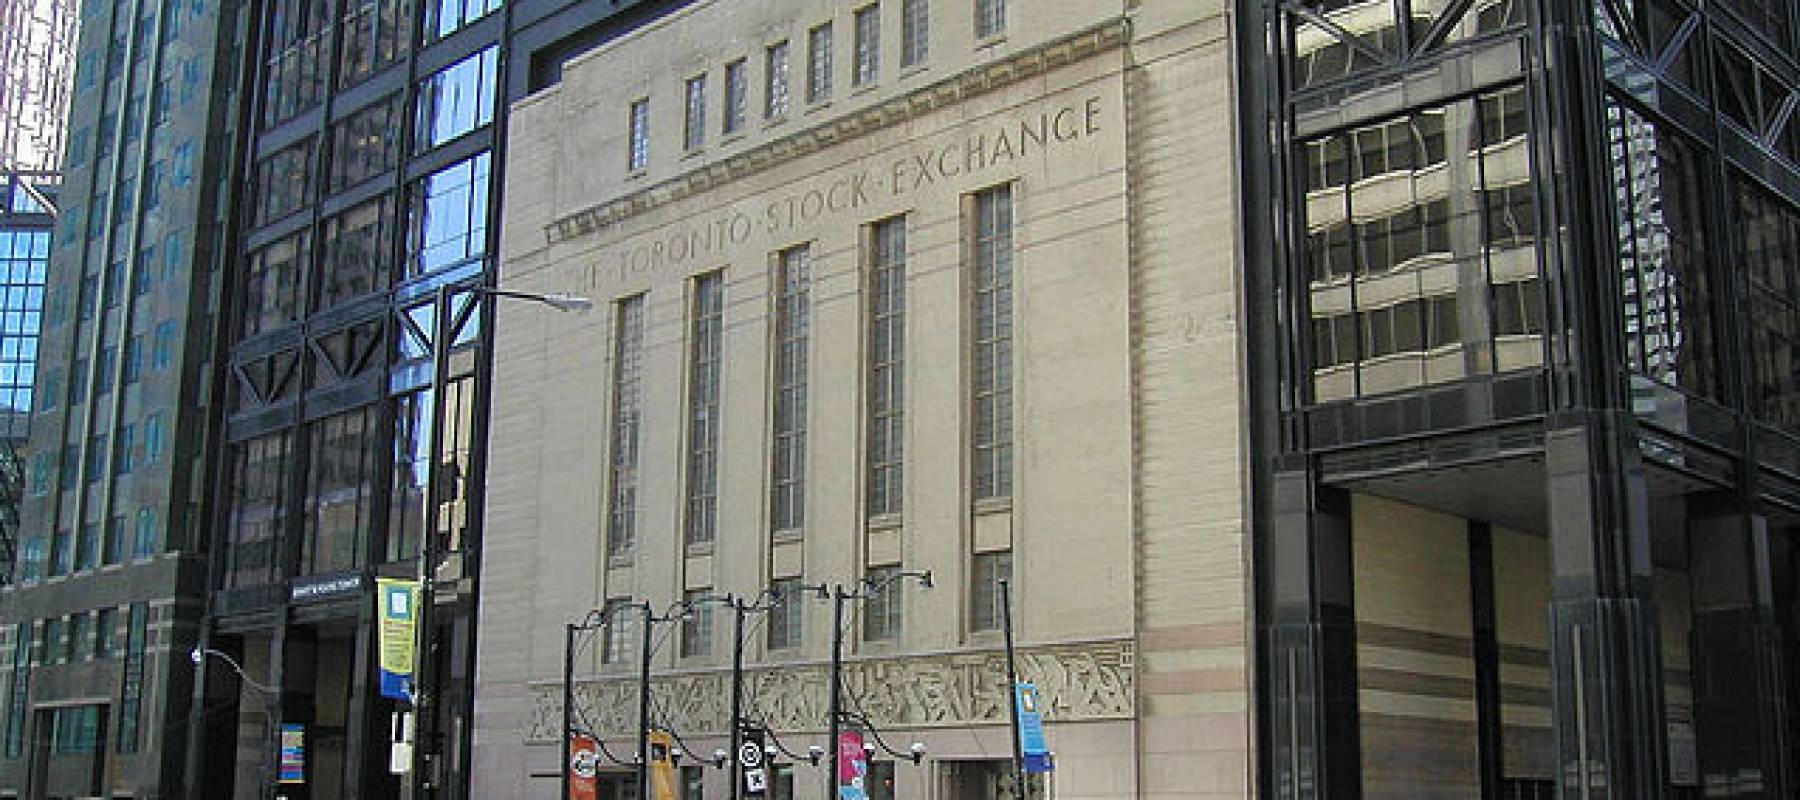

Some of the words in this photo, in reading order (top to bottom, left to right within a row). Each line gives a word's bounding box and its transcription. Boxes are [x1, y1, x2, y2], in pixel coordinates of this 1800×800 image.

[616, 212, 751, 281] TORONTO
[767, 171, 868, 233] STOCK
[892, 95, 1102, 197] EXCHANGE
